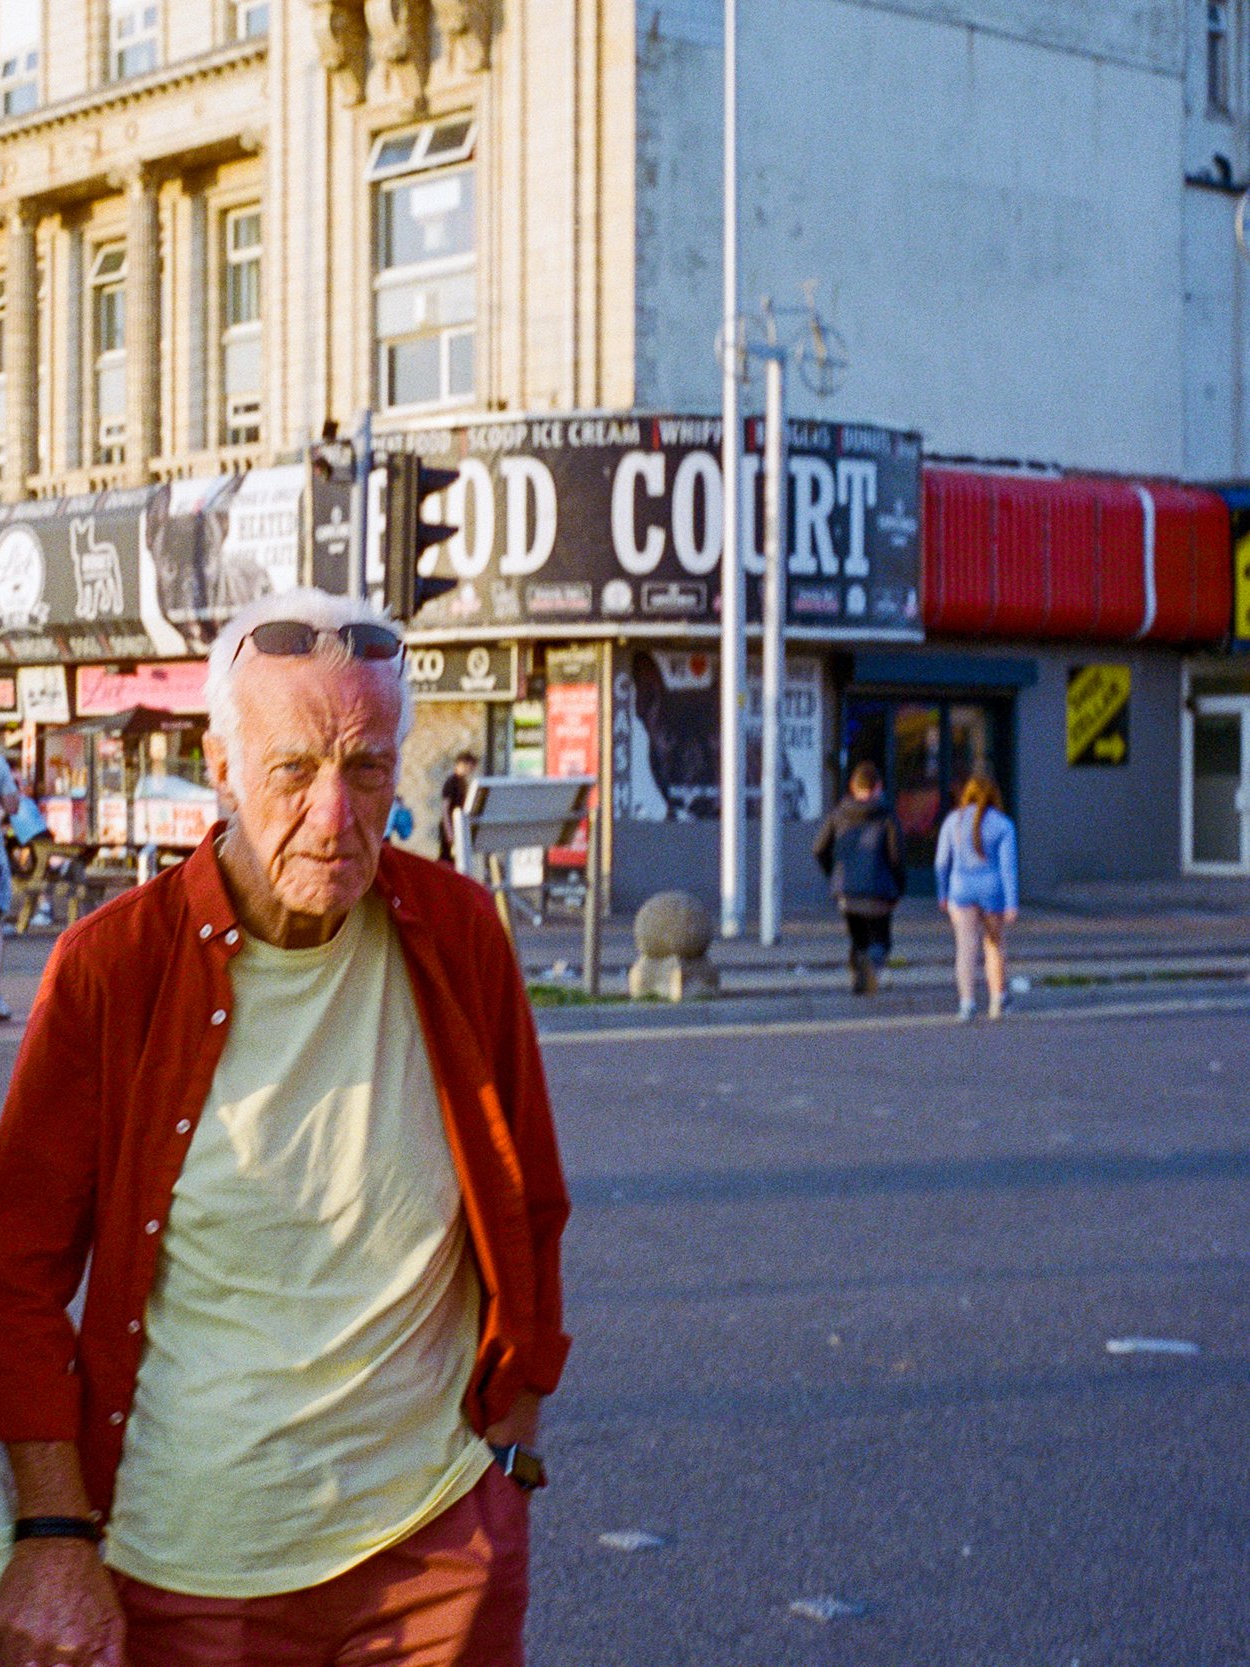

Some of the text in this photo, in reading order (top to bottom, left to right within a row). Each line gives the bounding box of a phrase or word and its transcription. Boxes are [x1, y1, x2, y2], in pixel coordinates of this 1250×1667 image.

[468, 419, 642, 450] SCOOP ICE CREAM
[660, 418, 725, 446] WHIPP
